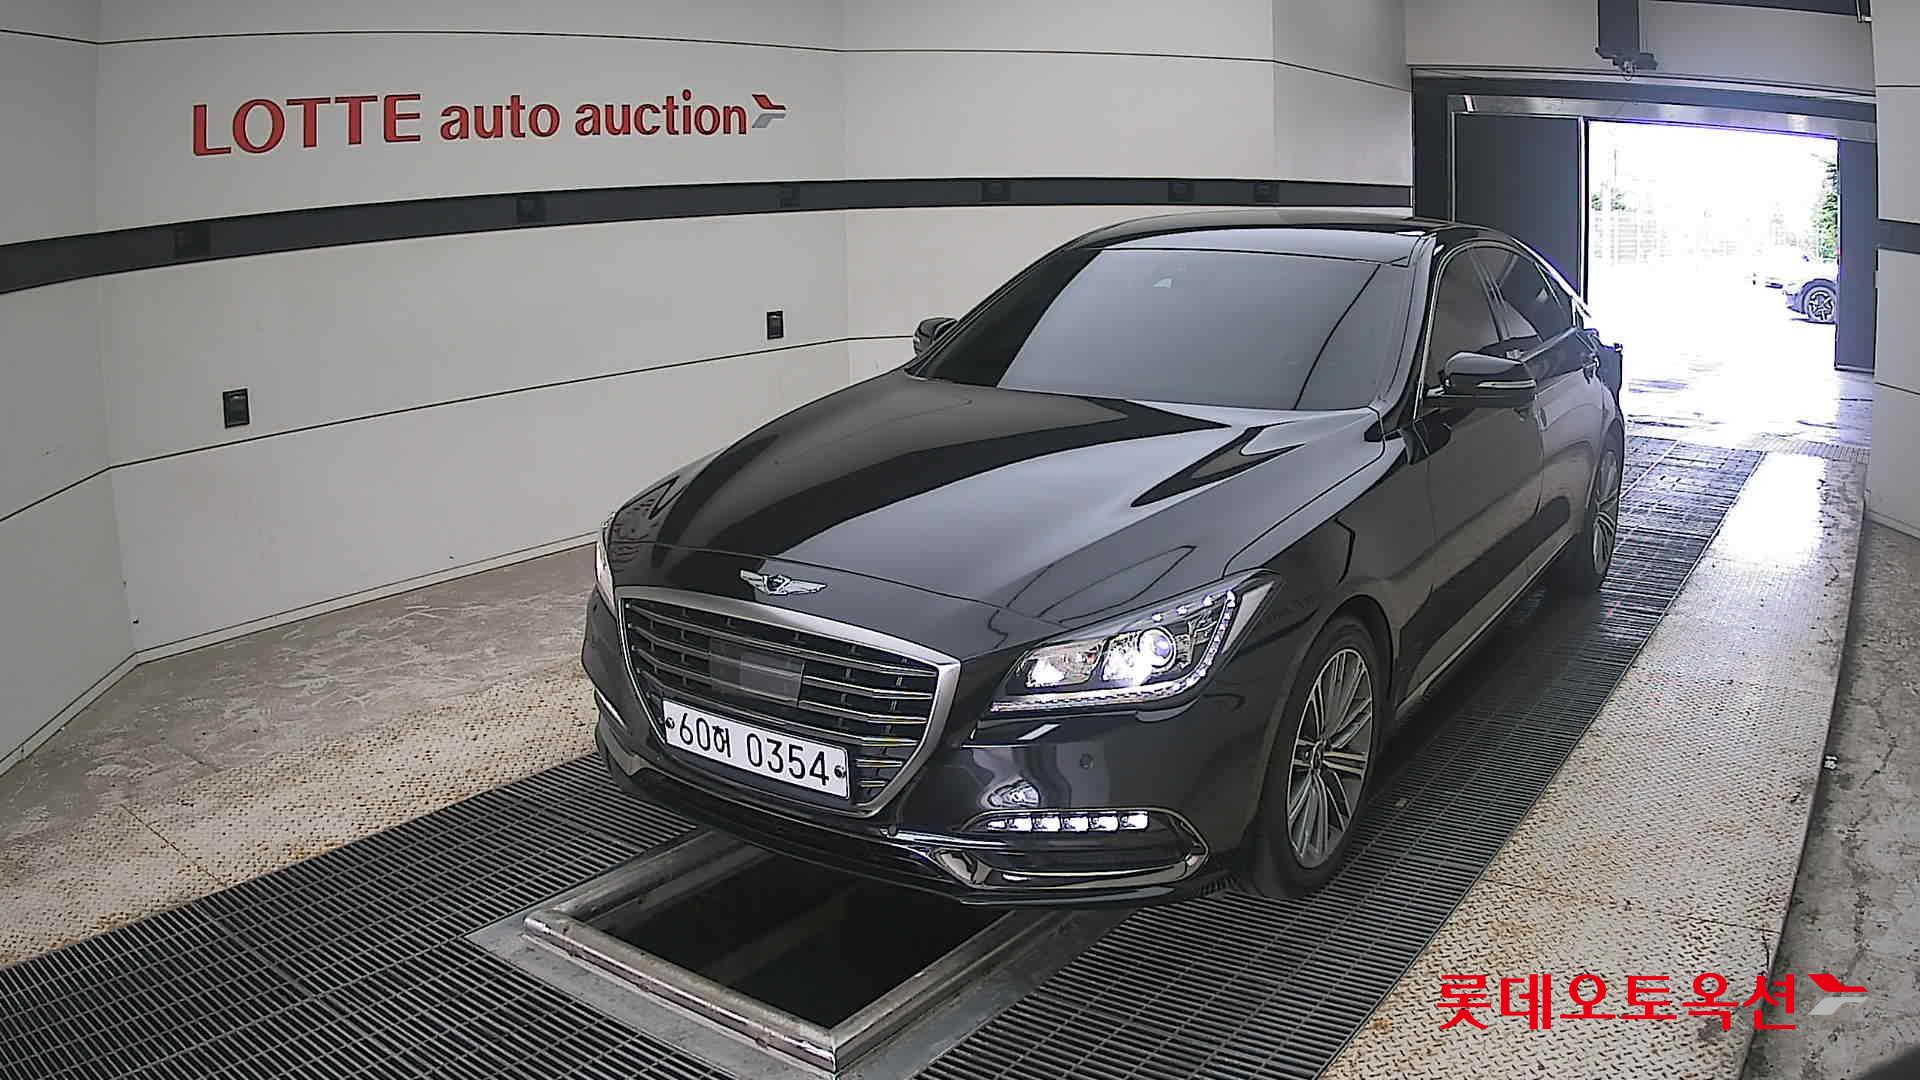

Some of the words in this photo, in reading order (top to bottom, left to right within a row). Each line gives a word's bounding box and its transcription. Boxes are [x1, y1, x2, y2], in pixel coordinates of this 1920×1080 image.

[192, 94, 421, 156] LOTTE
[440, 95, 560, 140] auto
[575, 89, 747, 136] auction
[679, 713, 732, 758] 60허
[746, 733, 830, 786] 0354
